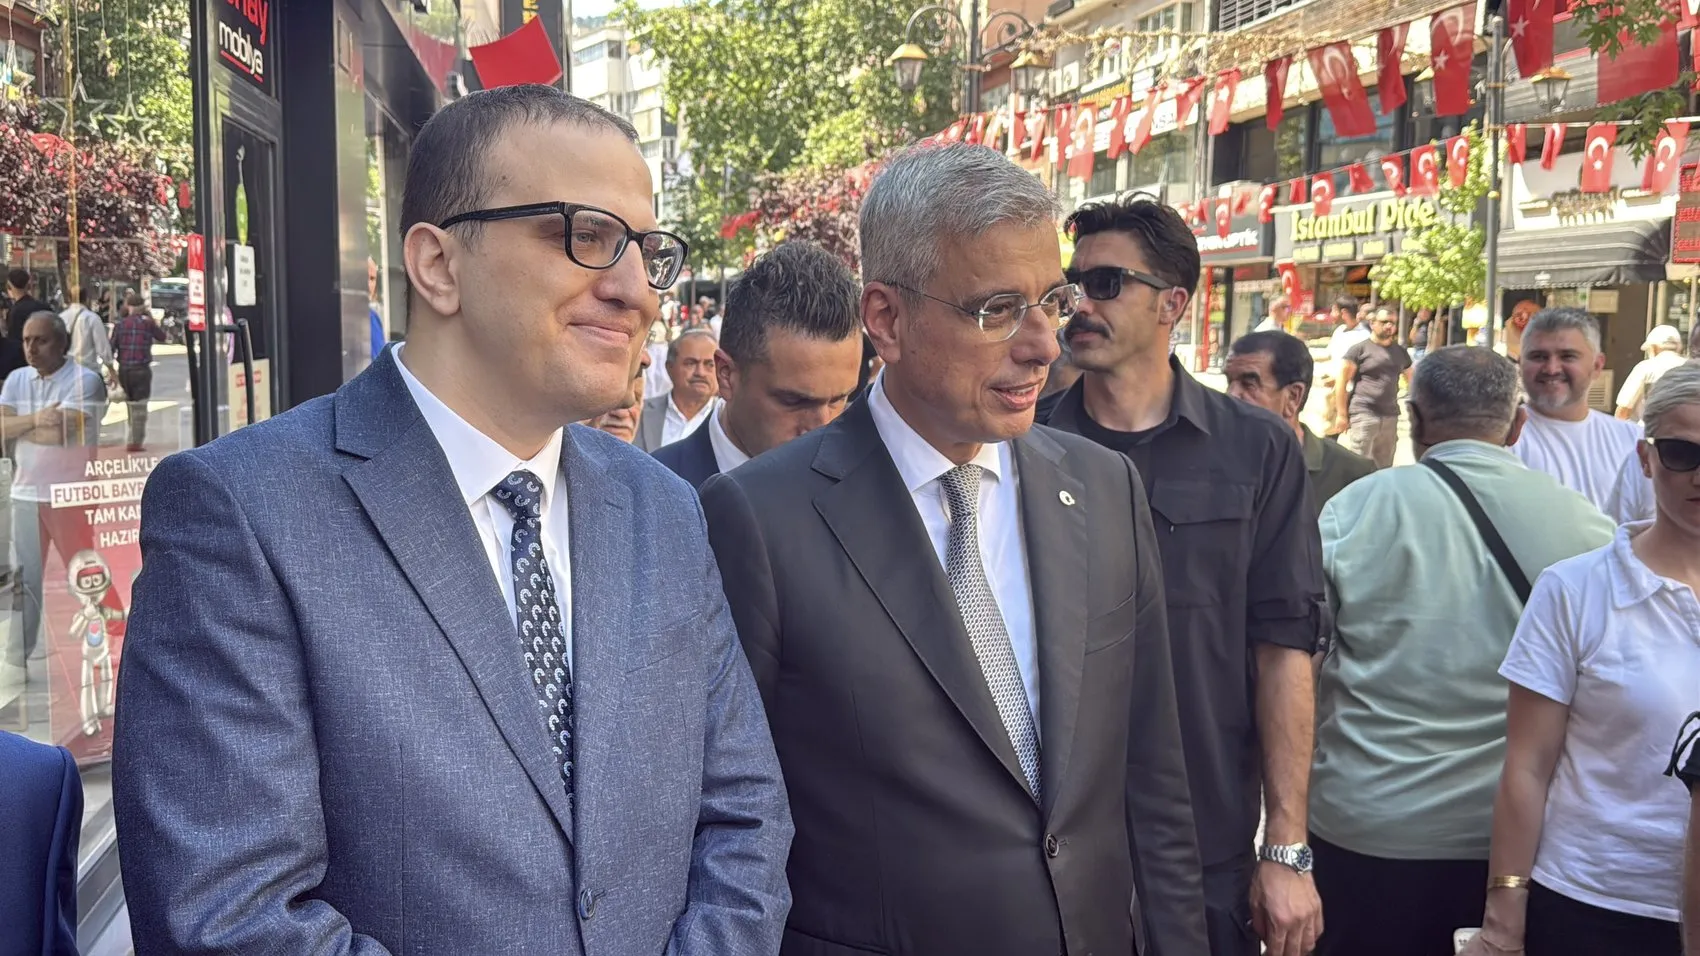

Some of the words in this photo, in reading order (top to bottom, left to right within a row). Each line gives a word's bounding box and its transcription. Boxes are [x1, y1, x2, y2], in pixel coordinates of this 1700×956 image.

[219, 20, 264, 75] mobilya
[1379, 195, 1435, 232] Pide
[54, 485, 109, 503] FUTBOL
[85, 507, 116, 525] TAM
